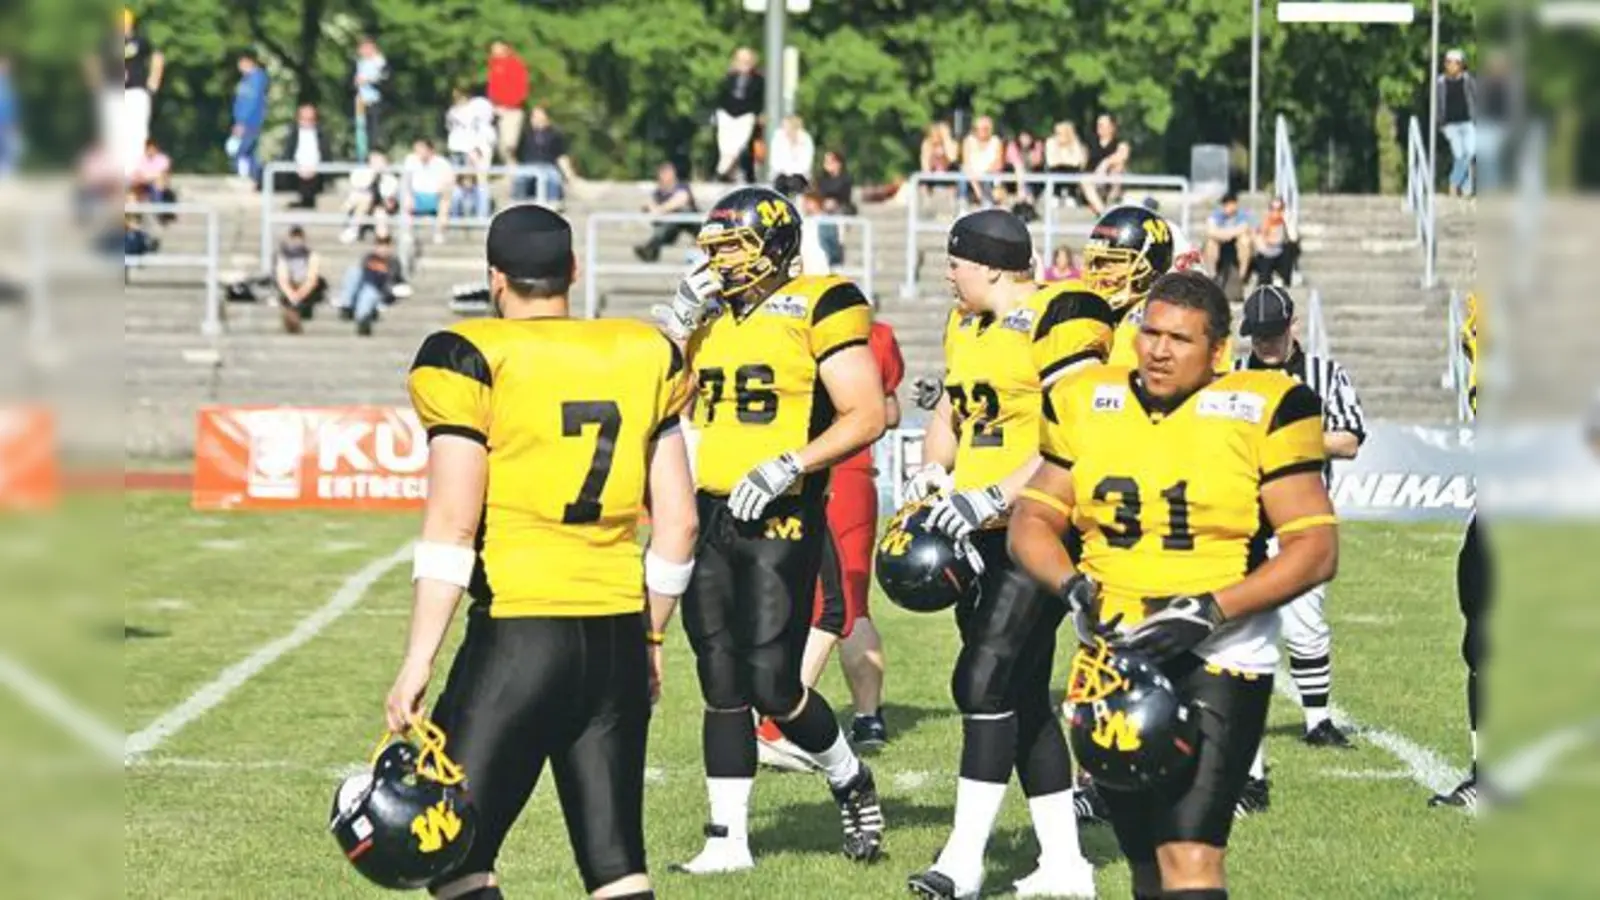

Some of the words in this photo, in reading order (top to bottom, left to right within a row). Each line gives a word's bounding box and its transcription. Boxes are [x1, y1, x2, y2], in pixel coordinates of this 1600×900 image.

[698, 364, 779, 425] 76
[561, 400, 622, 524] 7
[1092, 475, 1195, 550] 31
